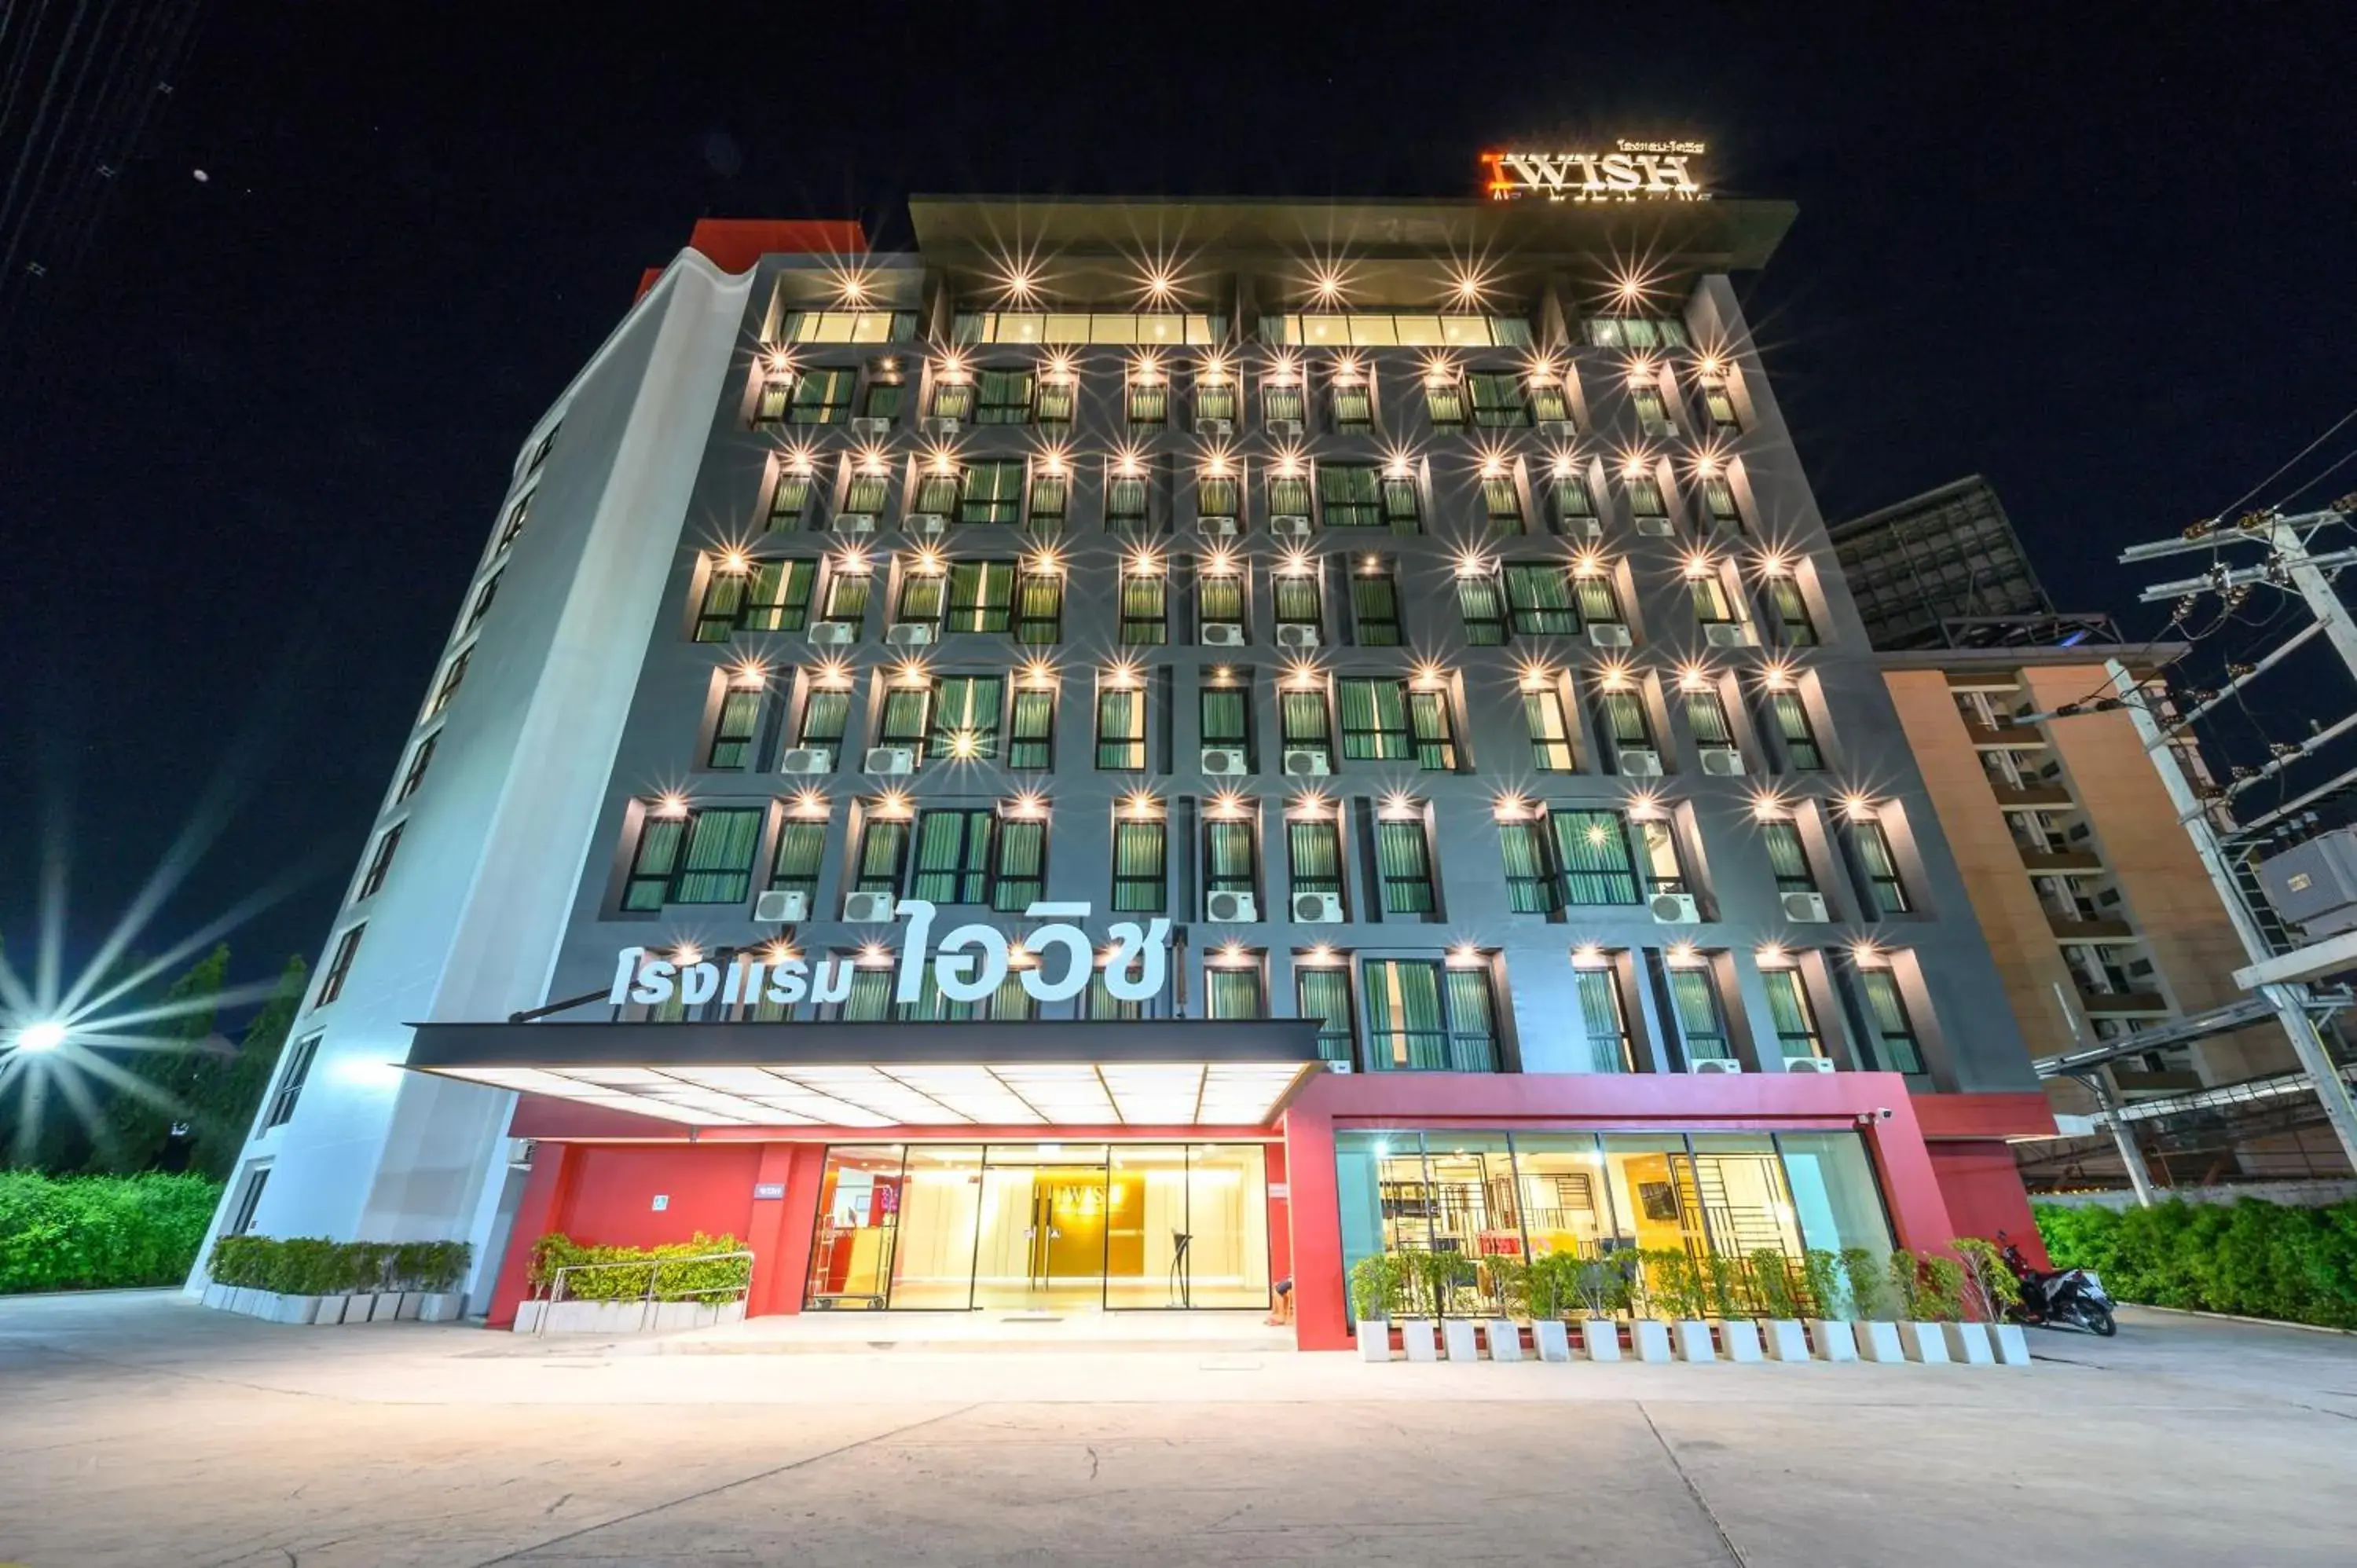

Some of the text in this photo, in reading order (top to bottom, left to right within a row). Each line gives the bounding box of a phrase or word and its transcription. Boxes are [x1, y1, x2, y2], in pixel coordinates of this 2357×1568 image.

[609, 899, 1171, 1005] โรงแรม ไอวิช
